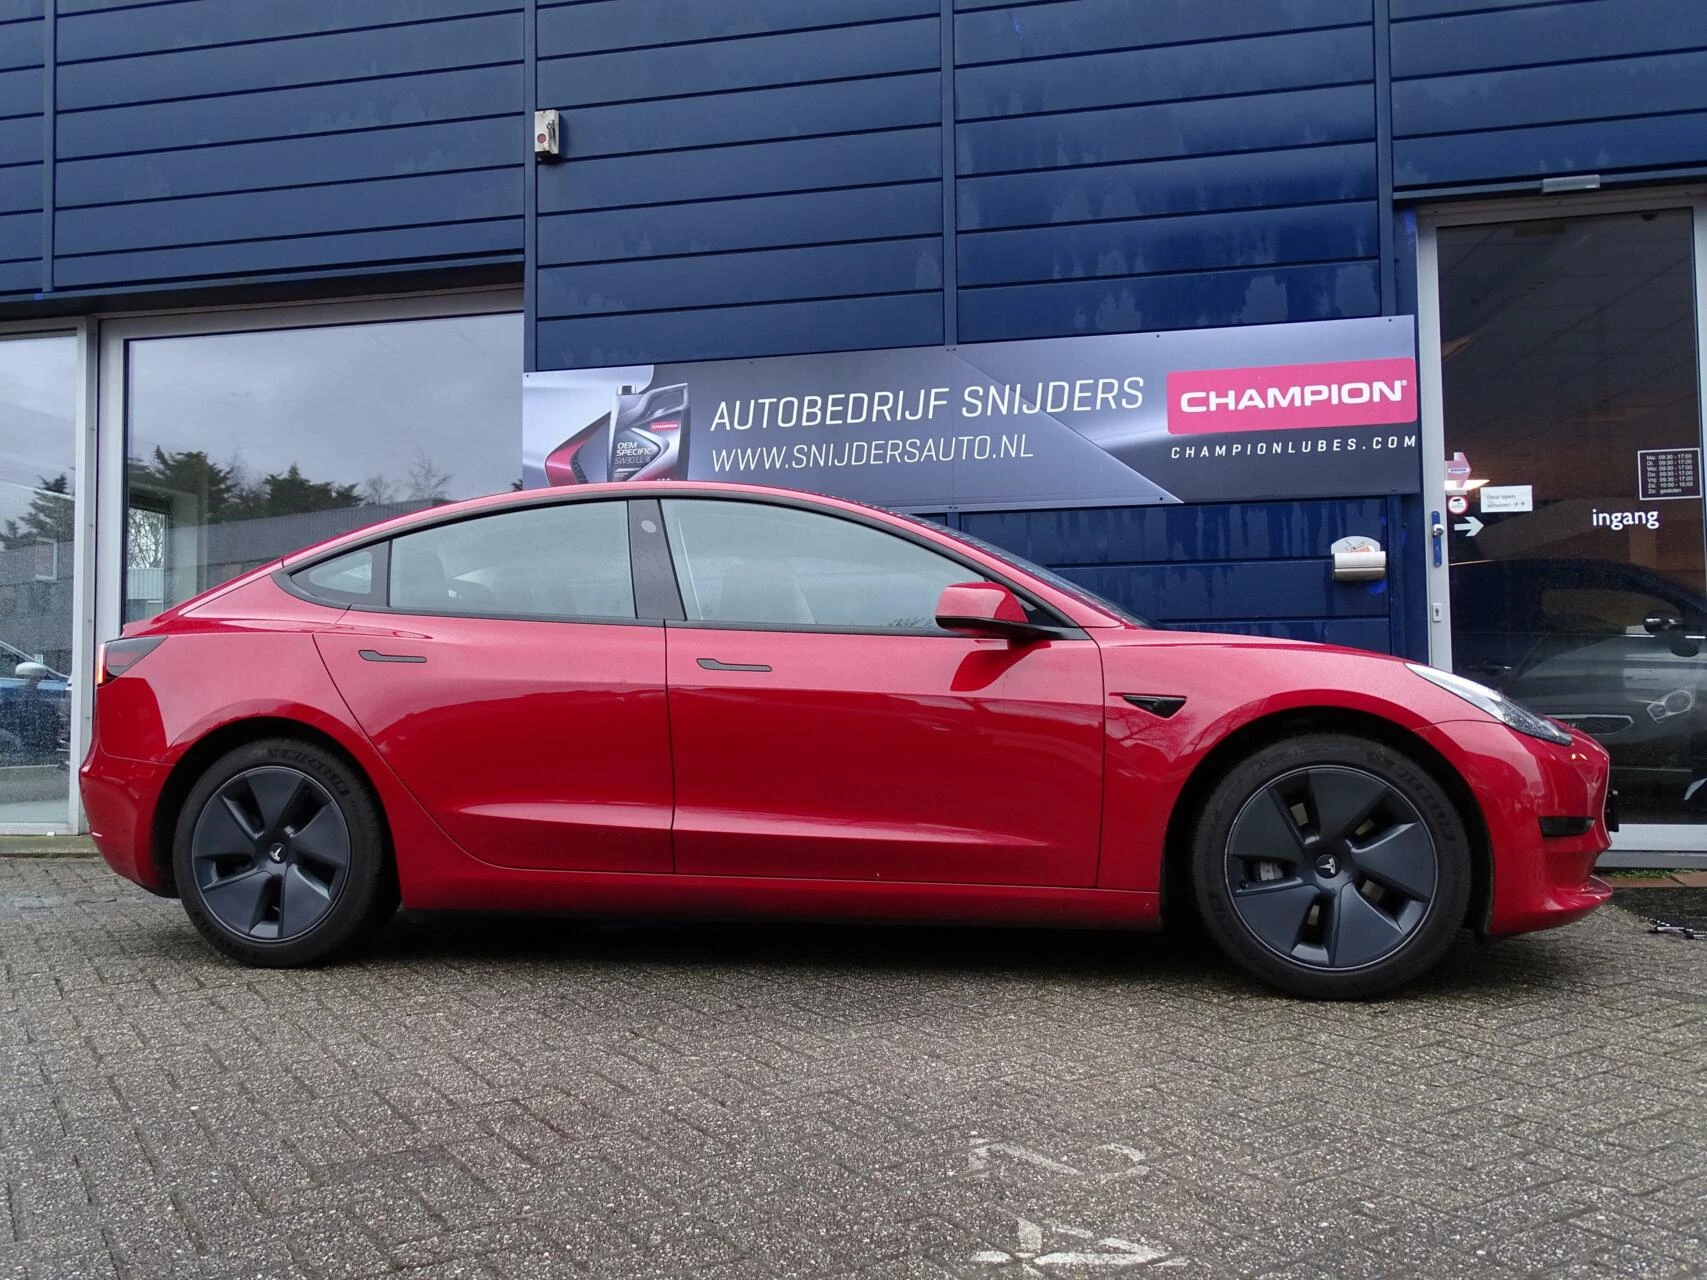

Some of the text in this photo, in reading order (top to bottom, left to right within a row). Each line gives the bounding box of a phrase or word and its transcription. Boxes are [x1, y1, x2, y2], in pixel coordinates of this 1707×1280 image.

[710, 376, 1145, 431] AUTOBEDRIJF SNIJDERS
[1180, 380, 1404, 413] CHAMPION
[615, 448, 653, 457] SPECIFIC
[617, 441, 638, 450] OEM
[711, 434, 1034, 473] WWW.SNIJDERSAUTO.NL
[1171, 434, 1416, 459] CHAMPIONLUBES.COM
[1592, 508, 1660, 531] ingang
